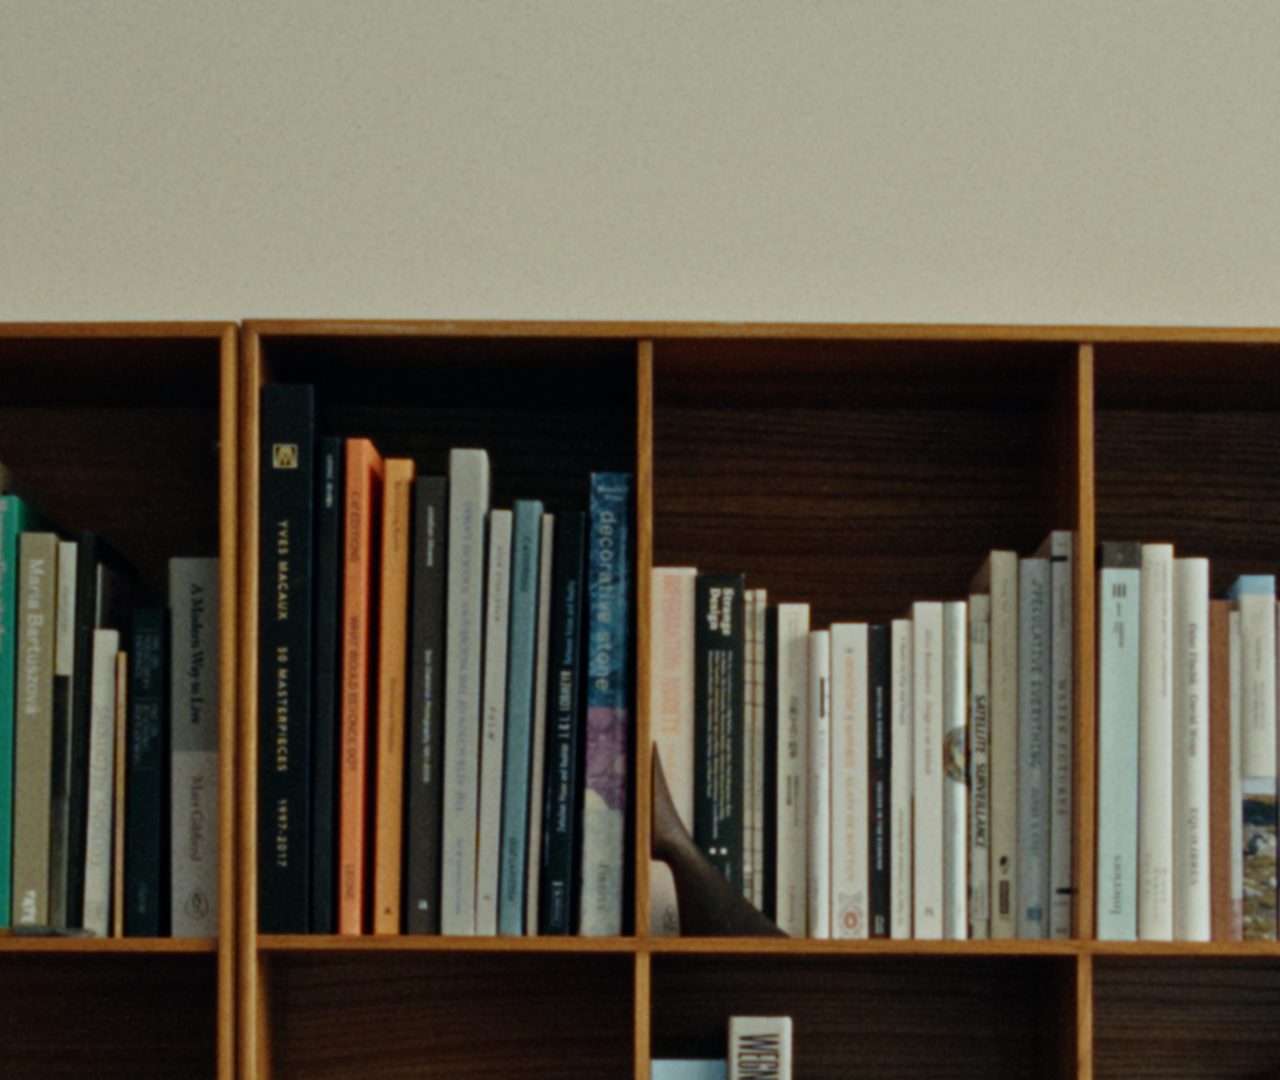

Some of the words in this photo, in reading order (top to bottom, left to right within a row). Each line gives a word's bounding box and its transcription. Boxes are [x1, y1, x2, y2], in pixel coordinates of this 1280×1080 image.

[277, 520, 289, 556] YVES
[596, 510, 618, 624] decorative
[28, 559, 45, 609] Maria
[190, 583, 204, 596] A
[277, 560, 289, 622] MACAUX
[707, 588, 723, 632] Design
[719, 588, 735, 638] Strange
[190, 597, 204, 649] Modern
[662, 574, 684, 671] INFORMATION
[1030, 578, 1044, 675] SPECULATIVE
[186, 652, 204, 682] Way
[190, 683, 203, 696] to
[593, 630, 617, 691] stone
[190, 697, 204, 726] Live
[276, 667, 288, 772] MASTERPIECES
[662, 675, 684, 736] ANXIETY
[973, 694, 988, 754] SATELLITE
[1030, 679, 1044, 768] EVERYTHING
[1056, 679, 1069, 735] WATER
[972, 761, 988, 849] SURVEILLANCE
[1056, 743, 1069, 816] FUTURES
